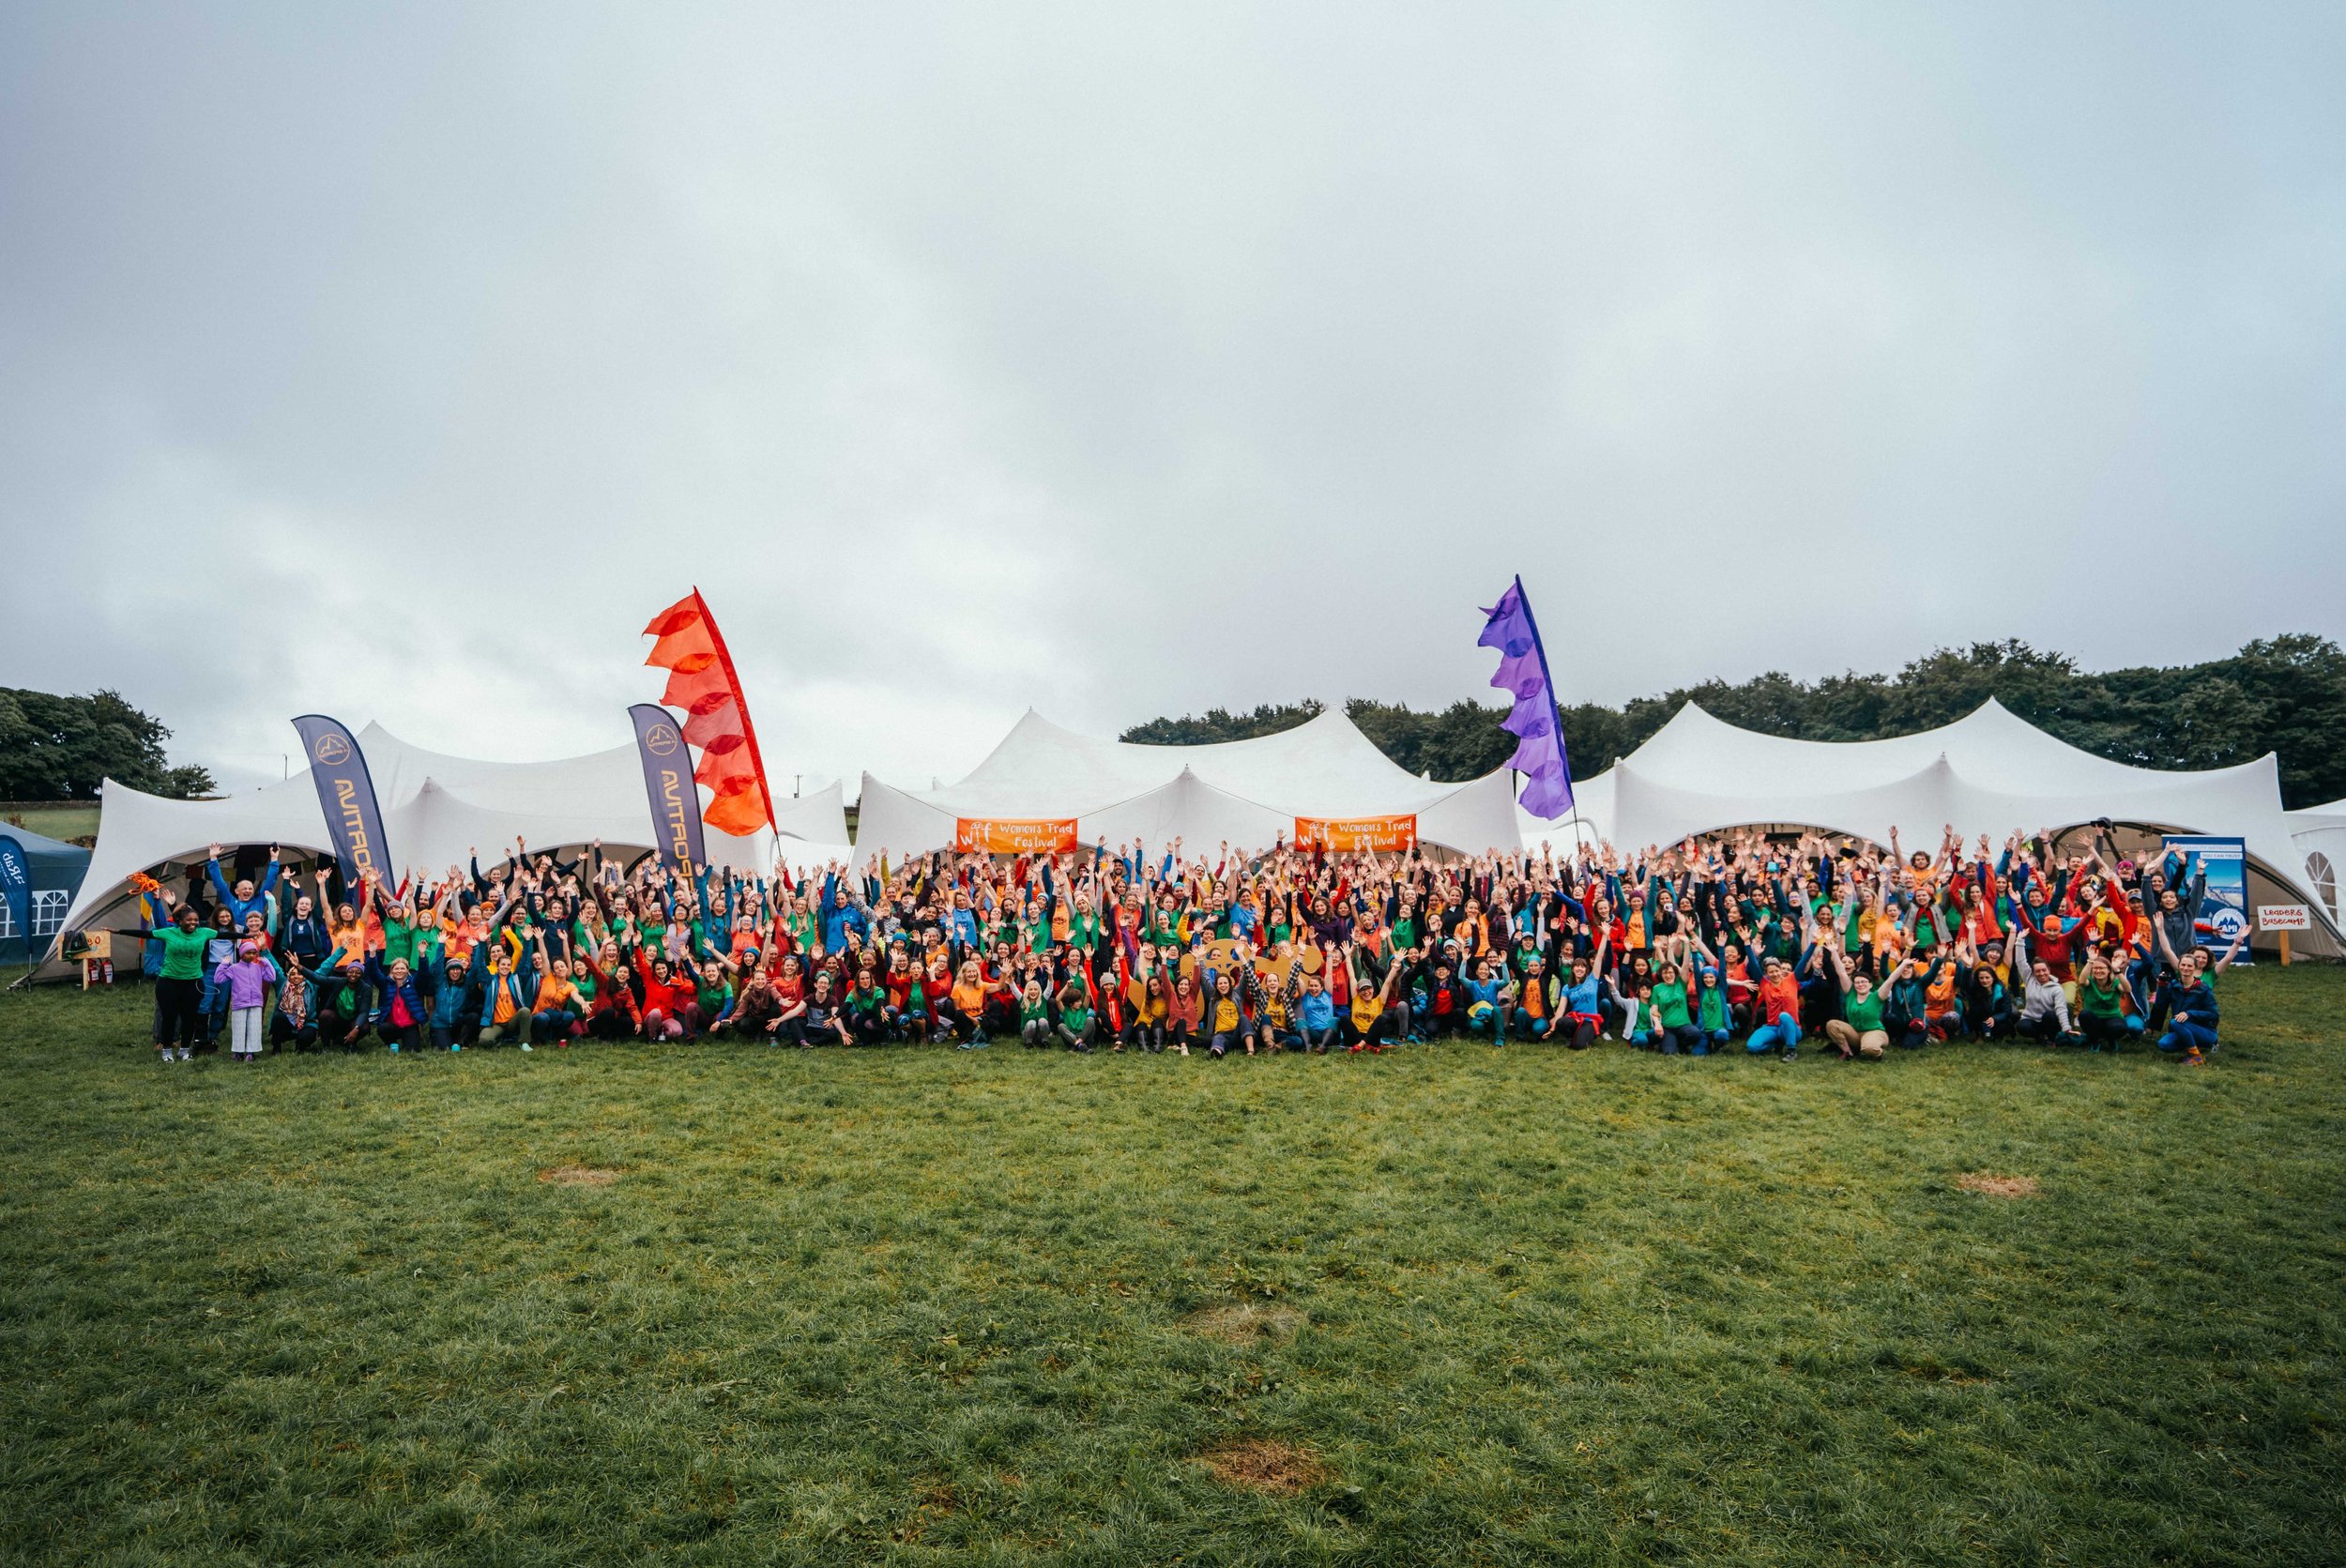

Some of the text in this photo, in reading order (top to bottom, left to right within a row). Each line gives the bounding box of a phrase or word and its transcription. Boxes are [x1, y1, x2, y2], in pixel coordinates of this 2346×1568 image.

[1045, 823, 1073, 834] Trad
[1386, 819, 1411, 831] Trad
[1014, 836, 1057, 848] Festival
[2221, 924, 2238, 933] AMI
